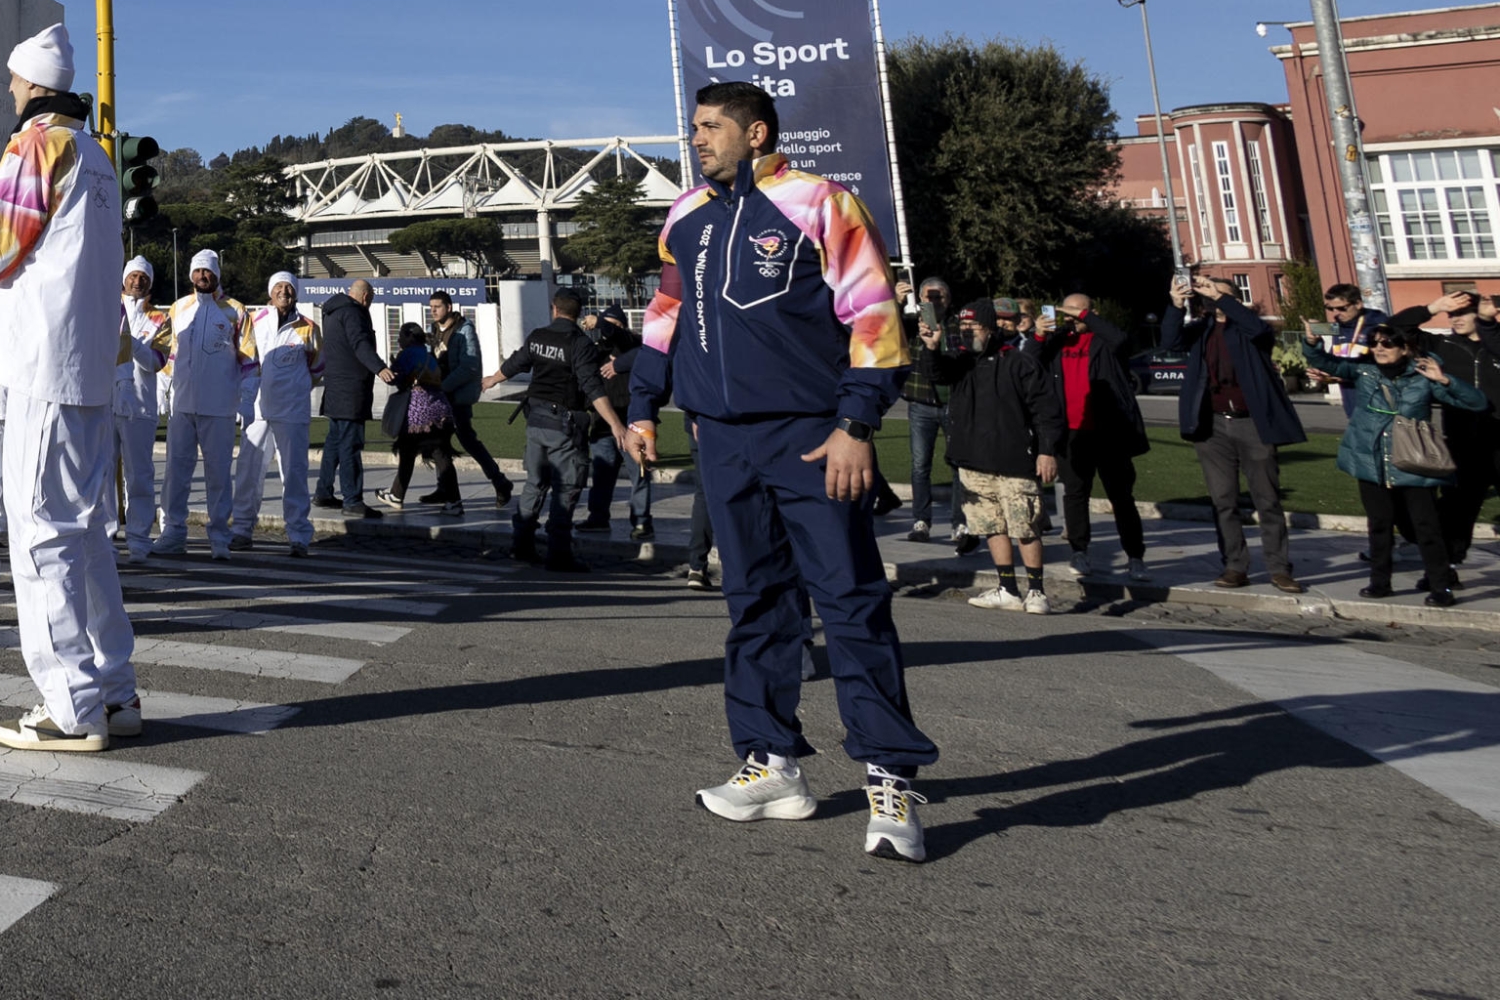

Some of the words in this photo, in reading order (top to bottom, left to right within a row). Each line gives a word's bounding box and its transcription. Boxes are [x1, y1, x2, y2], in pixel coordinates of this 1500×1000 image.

[705, 46, 746, 69] Lo
[752, 38, 850, 70] Sport
[750, 74, 796, 97] ita
[808, 142, 842, 155] sport
[790, 160, 798, 168] a
[800, 159, 816, 168] un
[699, 223, 714, 246] 2026
[694, 248, 708, 299] CORTINA
[304, 286, 346, 295] TRIBUNA
[392, 286, 434, 296] DISTINTI
[458, 287, 478, 296] EST
[696, 300, 709, 353] MILANO
[529, 341, 566, 362] POLIZIA
